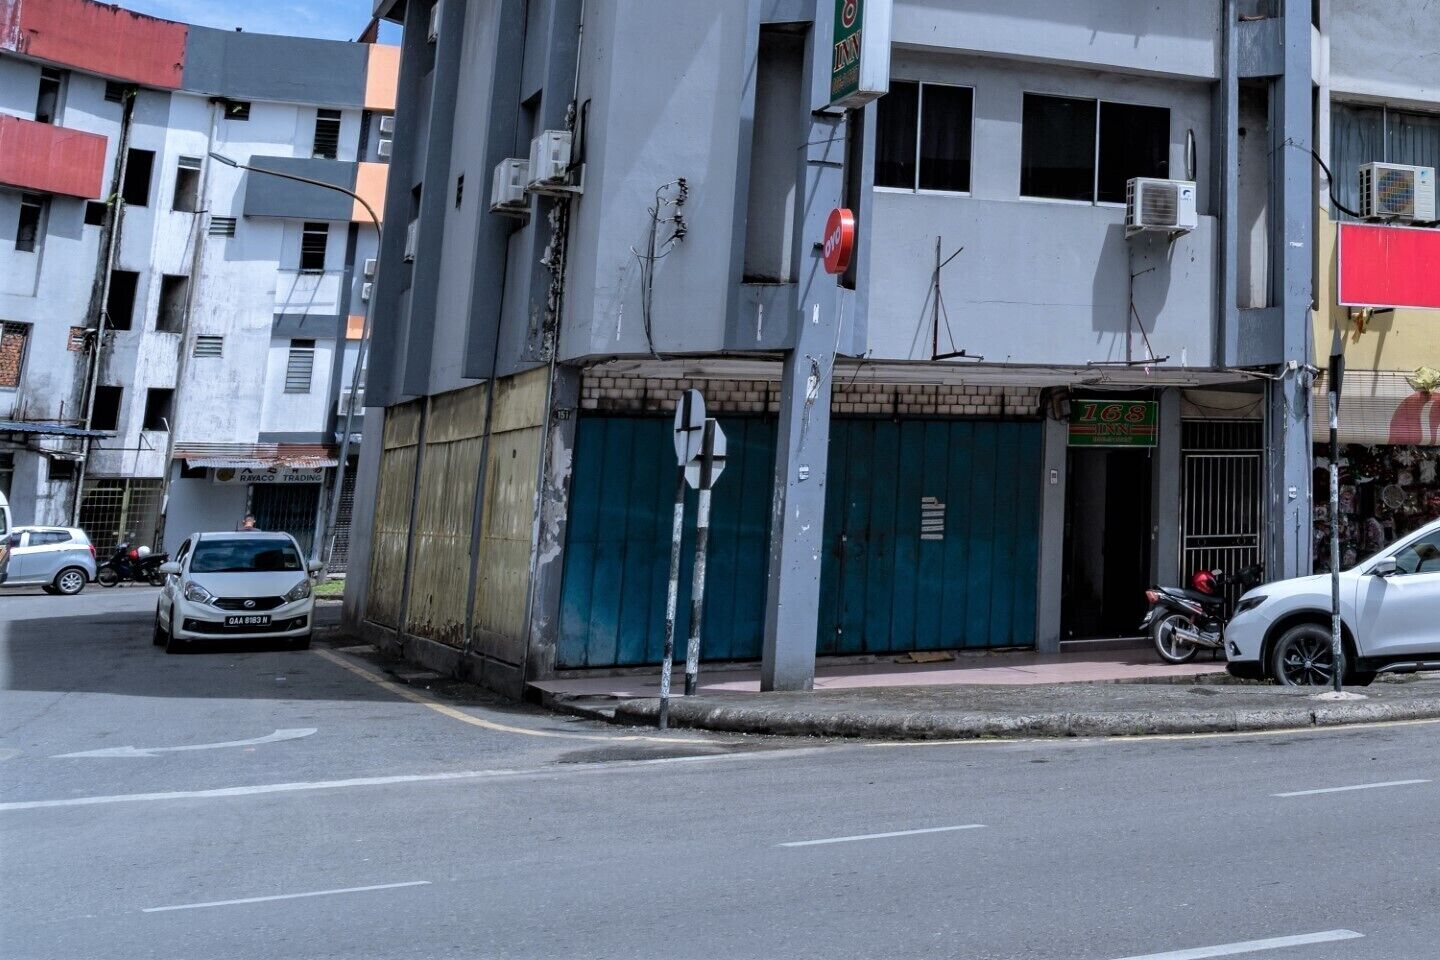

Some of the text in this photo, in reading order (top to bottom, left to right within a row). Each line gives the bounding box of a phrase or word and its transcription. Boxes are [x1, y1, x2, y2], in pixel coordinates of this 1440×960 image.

[834, 29, 861, 73] INN
[825, 226, 840, 258] OYO
[1080, 404, 1146, 422] 168
[1094, 423, 1132, 435] INN
